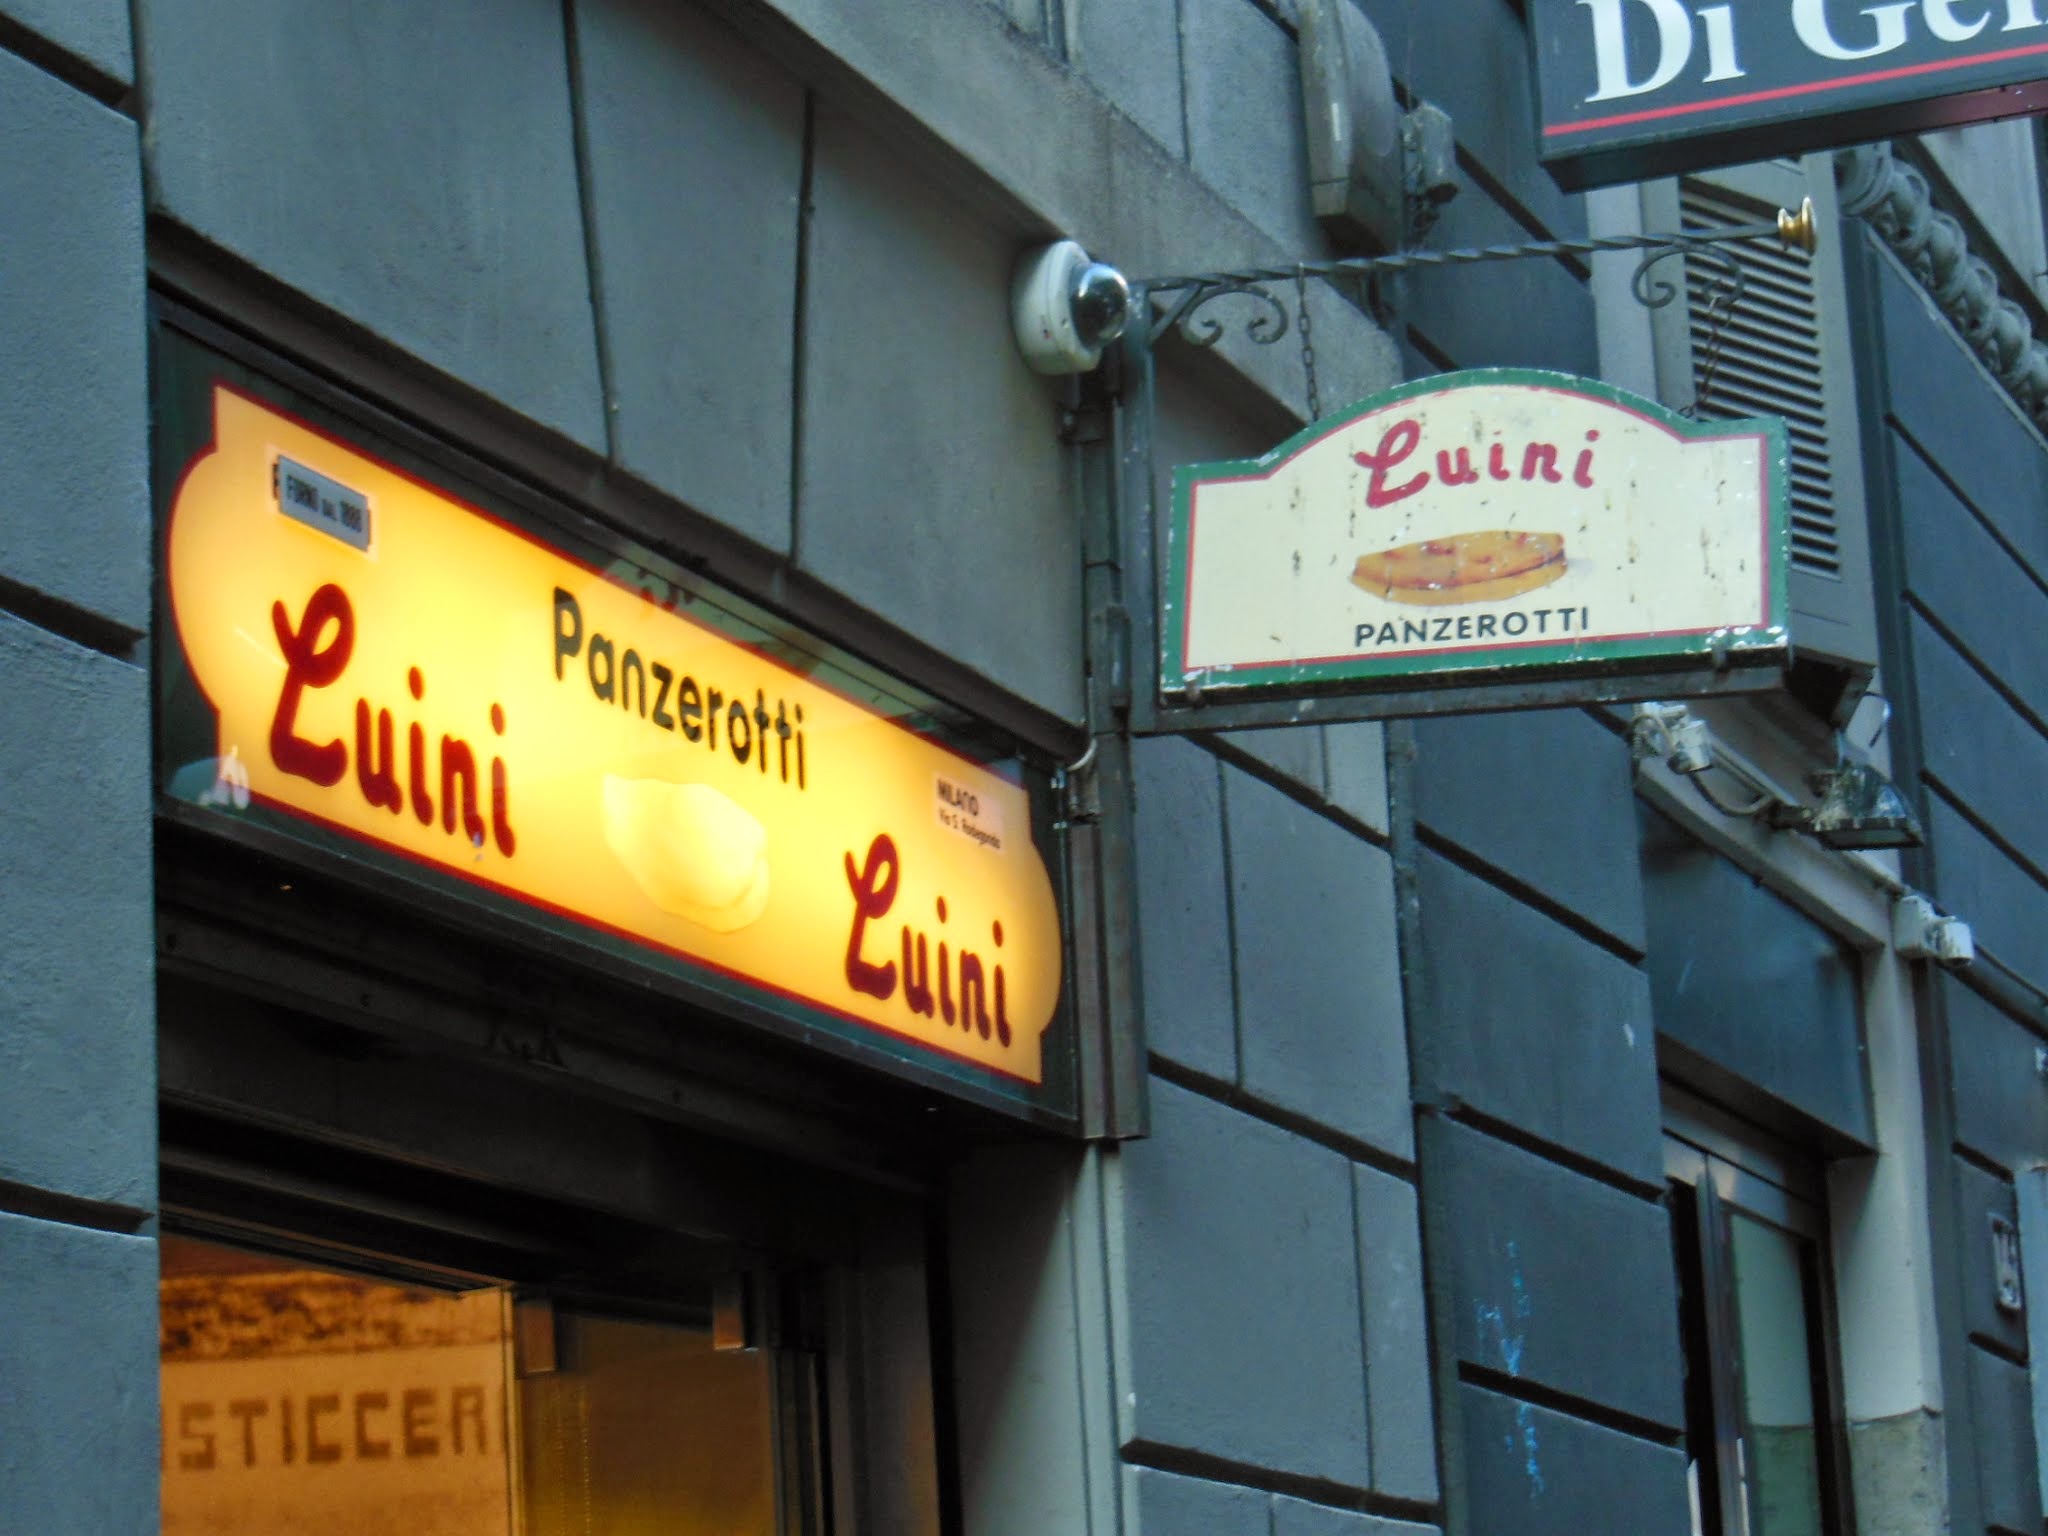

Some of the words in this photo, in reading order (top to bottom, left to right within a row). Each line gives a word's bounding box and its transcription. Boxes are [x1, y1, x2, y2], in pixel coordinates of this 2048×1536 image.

[1576, 0, 1746, 103] Di
[1354, 419, 1600, 508] Luini
[552, 587, 808, 790] Panzerotti
[1354, 606, 1589, 647] PANZEROTTI
[270, 584, 517, 859] Luini
[843, 834, 1013, 1049] Luini
